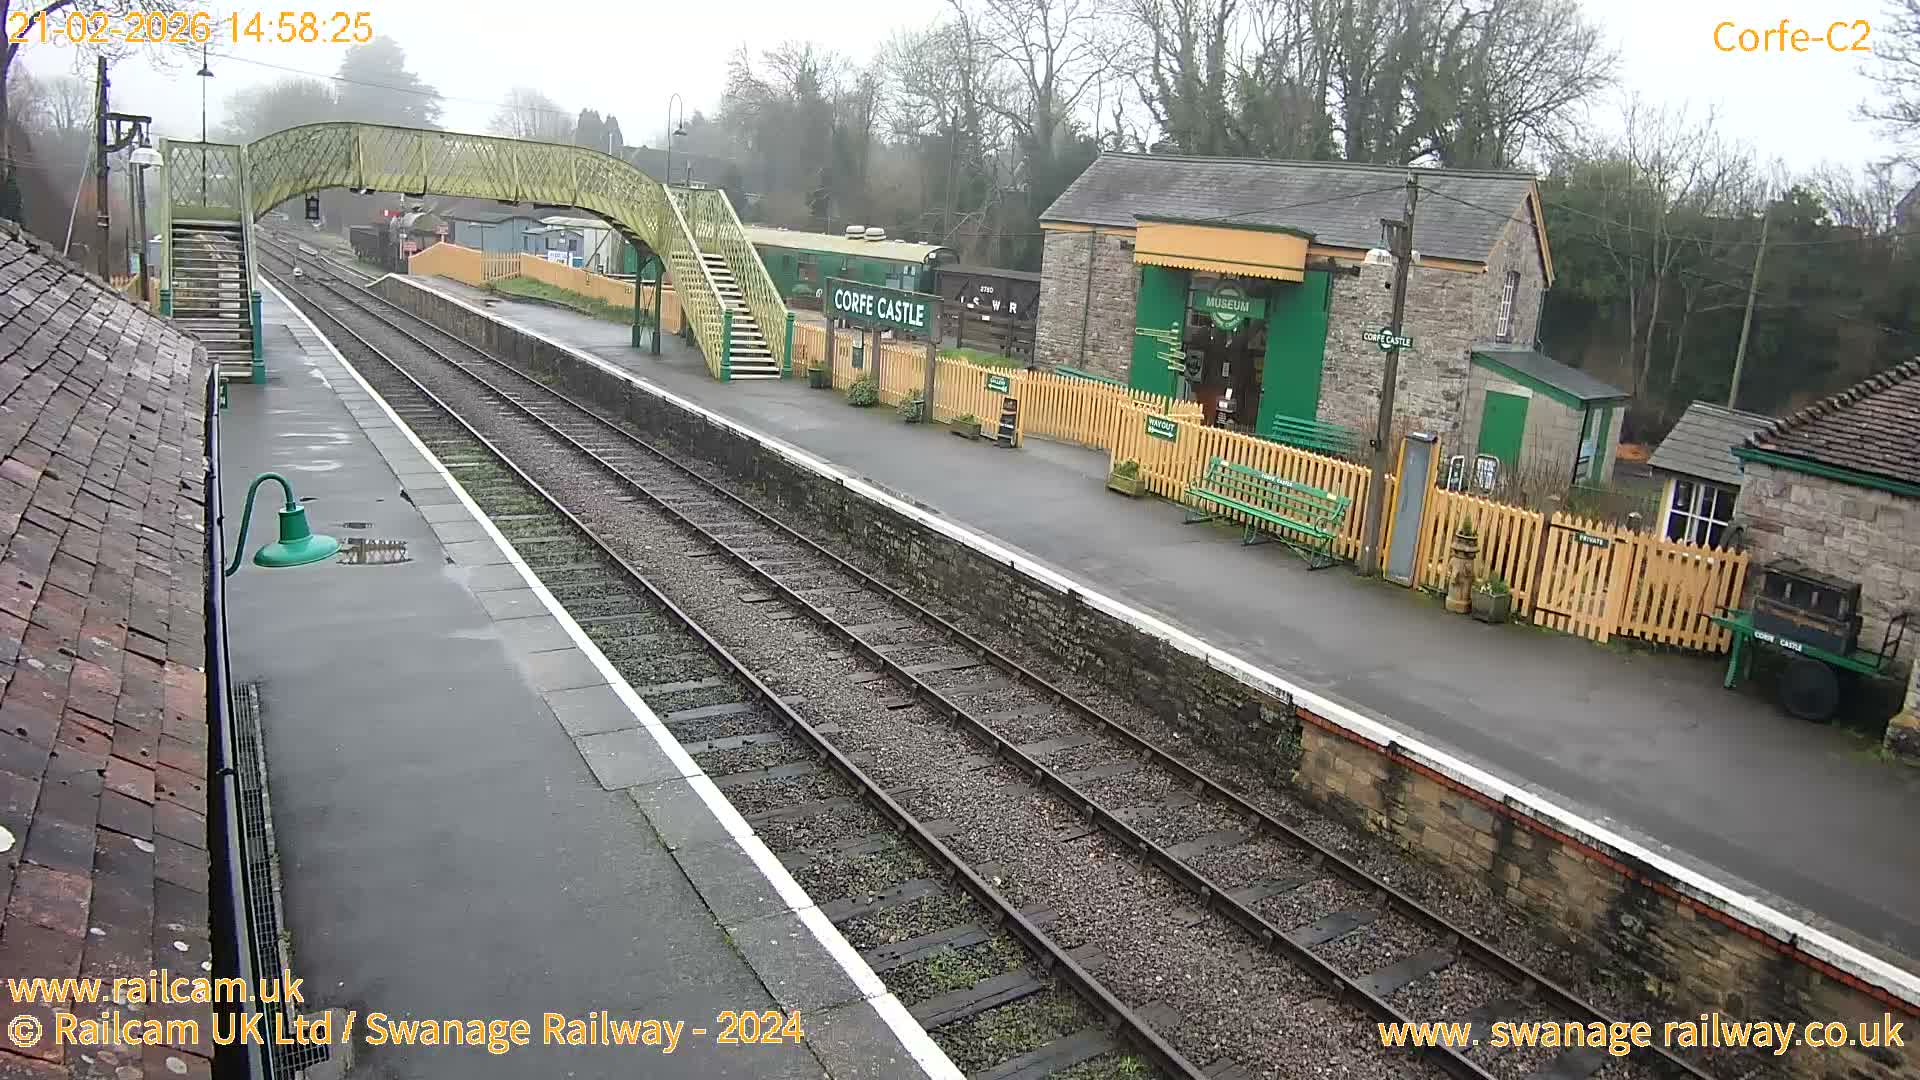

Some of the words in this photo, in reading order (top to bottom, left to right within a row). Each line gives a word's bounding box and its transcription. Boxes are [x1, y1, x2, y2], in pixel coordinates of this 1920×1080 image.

[835, 289, 874, 316] CORFE
[877, 297, 925, 327] CASTLE
[1206, 295, 1250, 313] MUSEUM
[1363, 332, 1385, 343] CORFE
[1386, 336, 1411, 347] CASTLE
